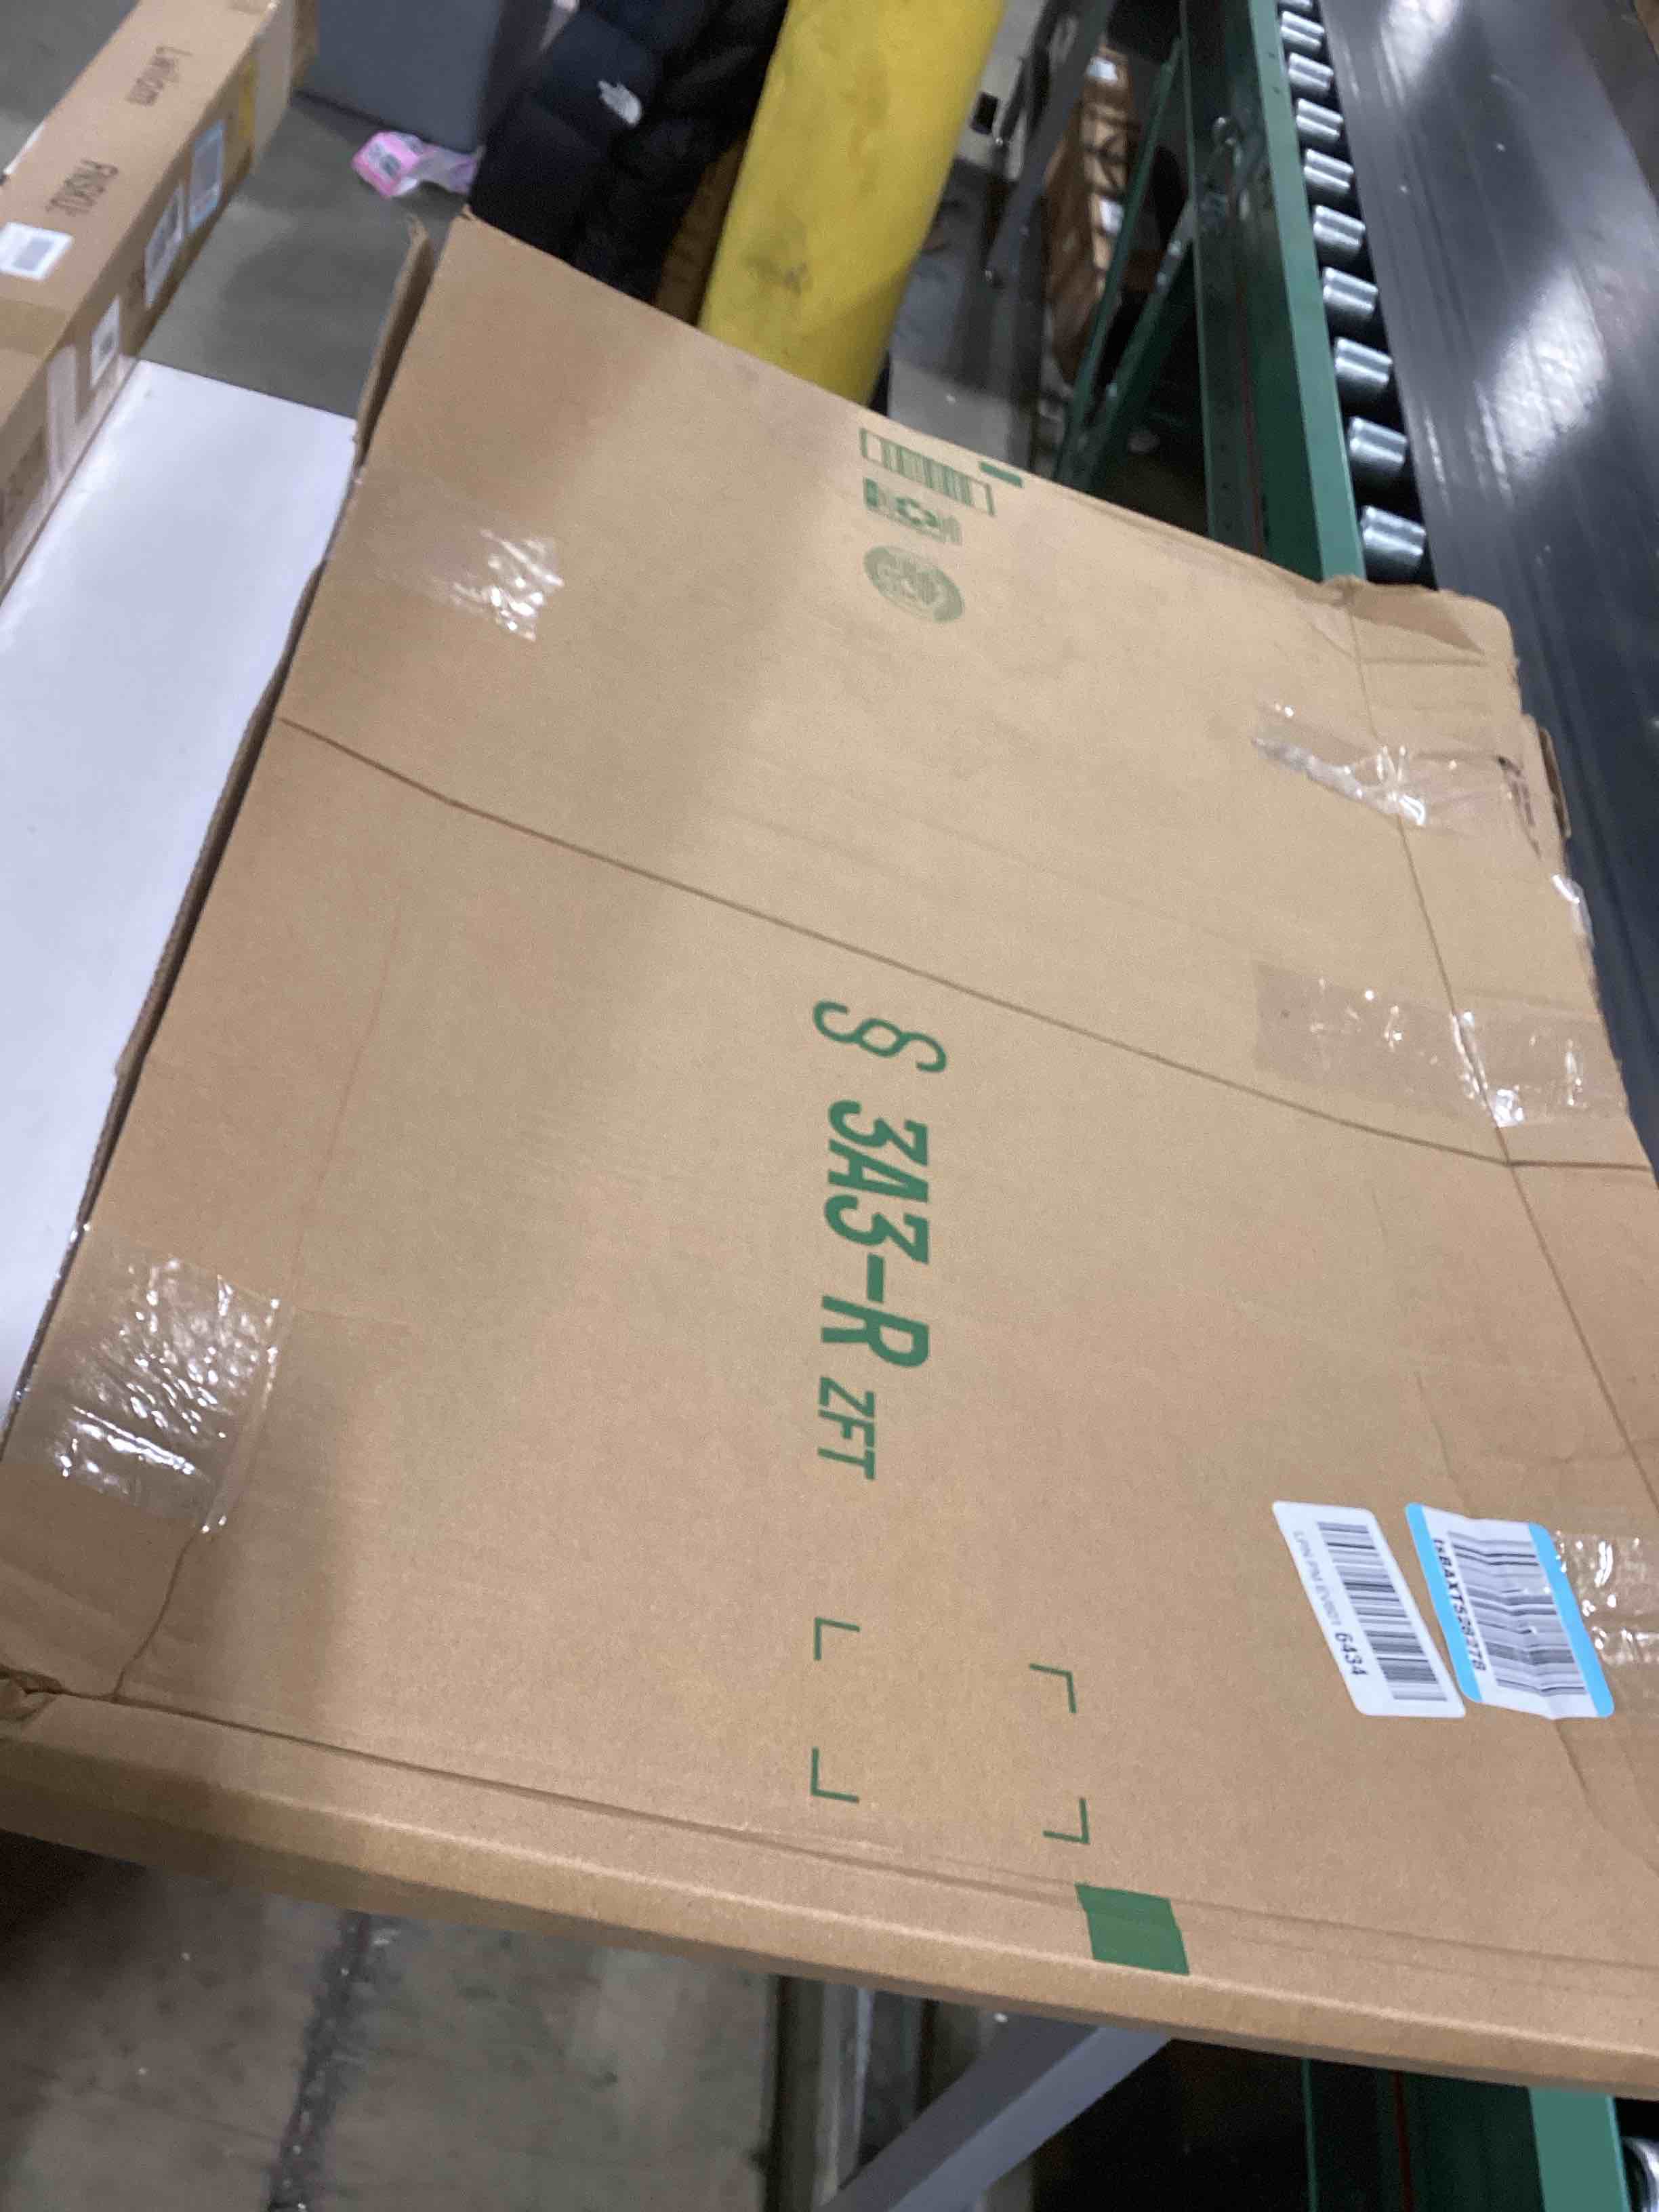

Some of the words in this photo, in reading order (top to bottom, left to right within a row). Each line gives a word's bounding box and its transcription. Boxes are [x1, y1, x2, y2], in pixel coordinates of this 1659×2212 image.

[822, 1099, 930, 1368] 3A3-R
[817, 1376, 876, 1481] ZFT
[1335, 1632, 1369, 1676] 6434
